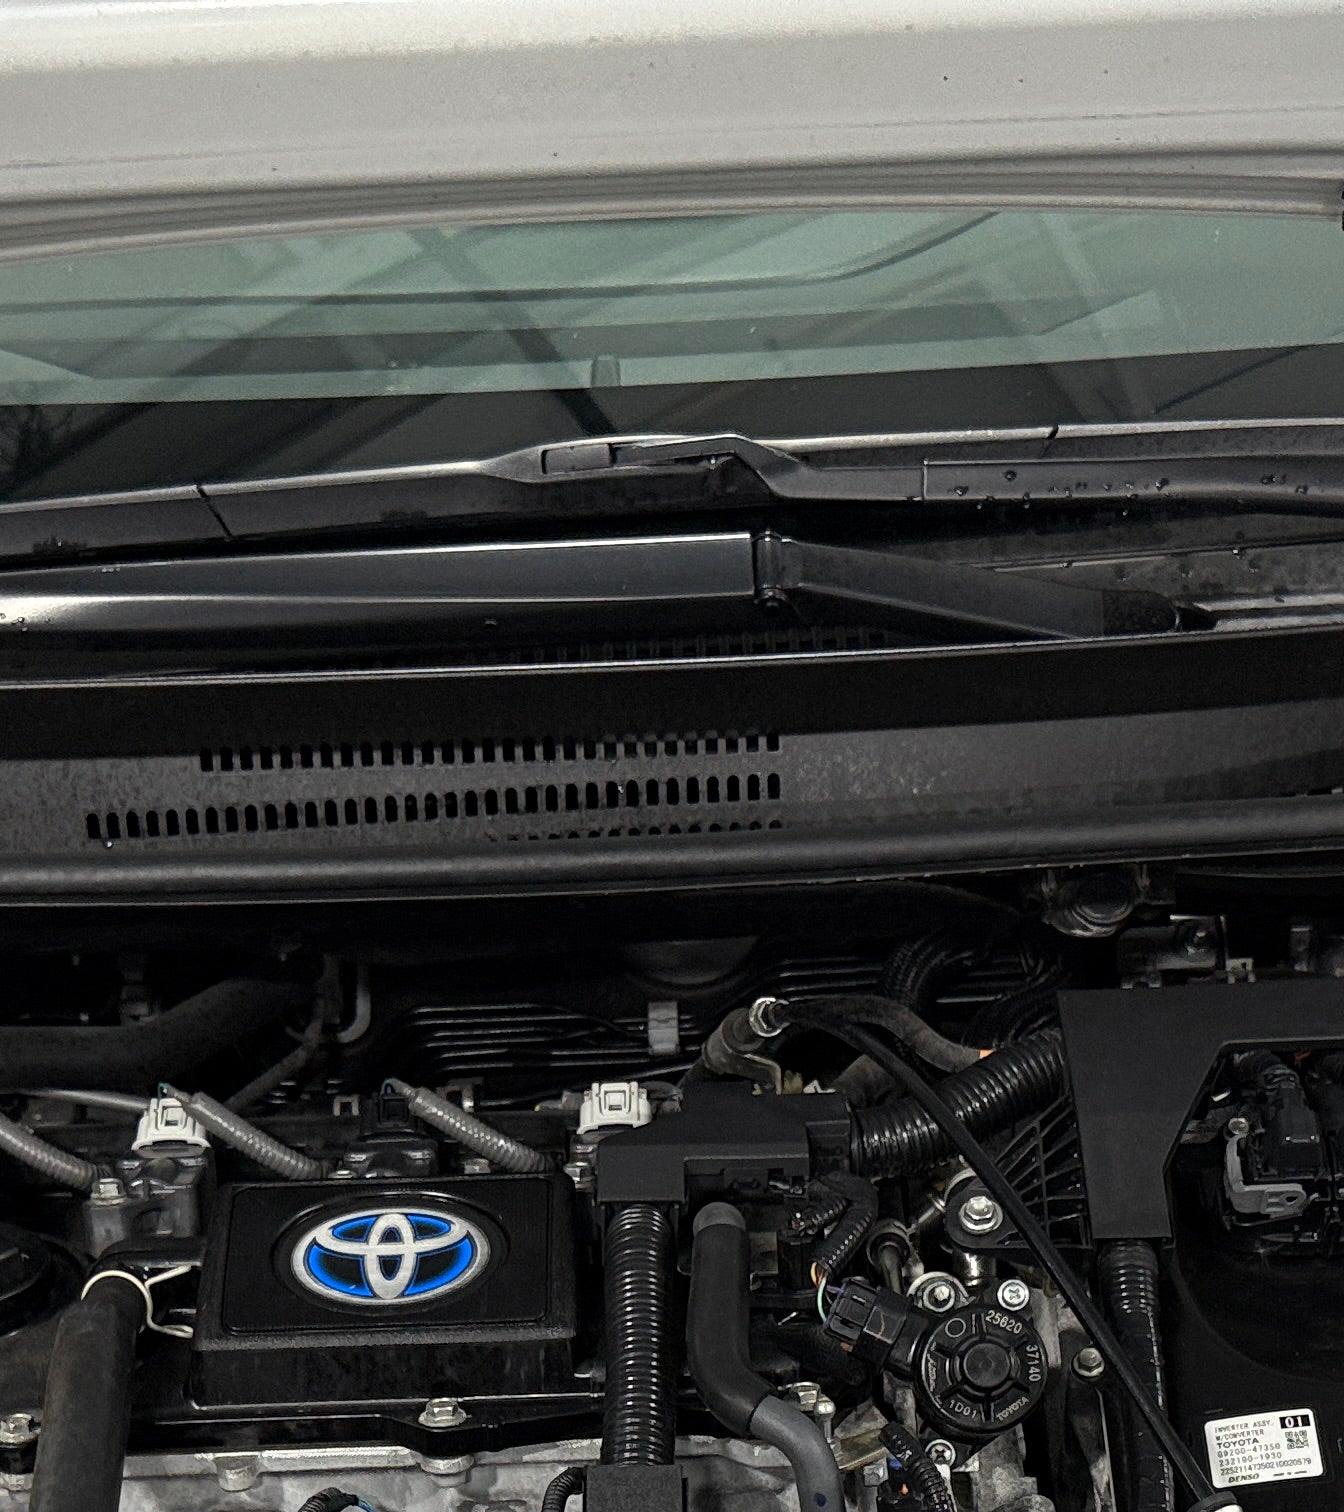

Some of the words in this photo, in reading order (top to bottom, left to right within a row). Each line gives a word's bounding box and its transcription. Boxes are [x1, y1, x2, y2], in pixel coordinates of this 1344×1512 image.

[985, 1309, 1023, 1334] 25620
[1025, 1345, 1042, 1382] 37140
[995, 1396, 1030, 1421] TOYOTA
[1215, 1423, 1249, 1433] INVERTER
[1284, 1416, 1303, 1428] 01
[1215, 1429, 1265, 1441] W/CONVERTER
[1216, 1438, 1260, 1449] TOYOTA
[1228, 1472, 1260, 1484] DENSO
